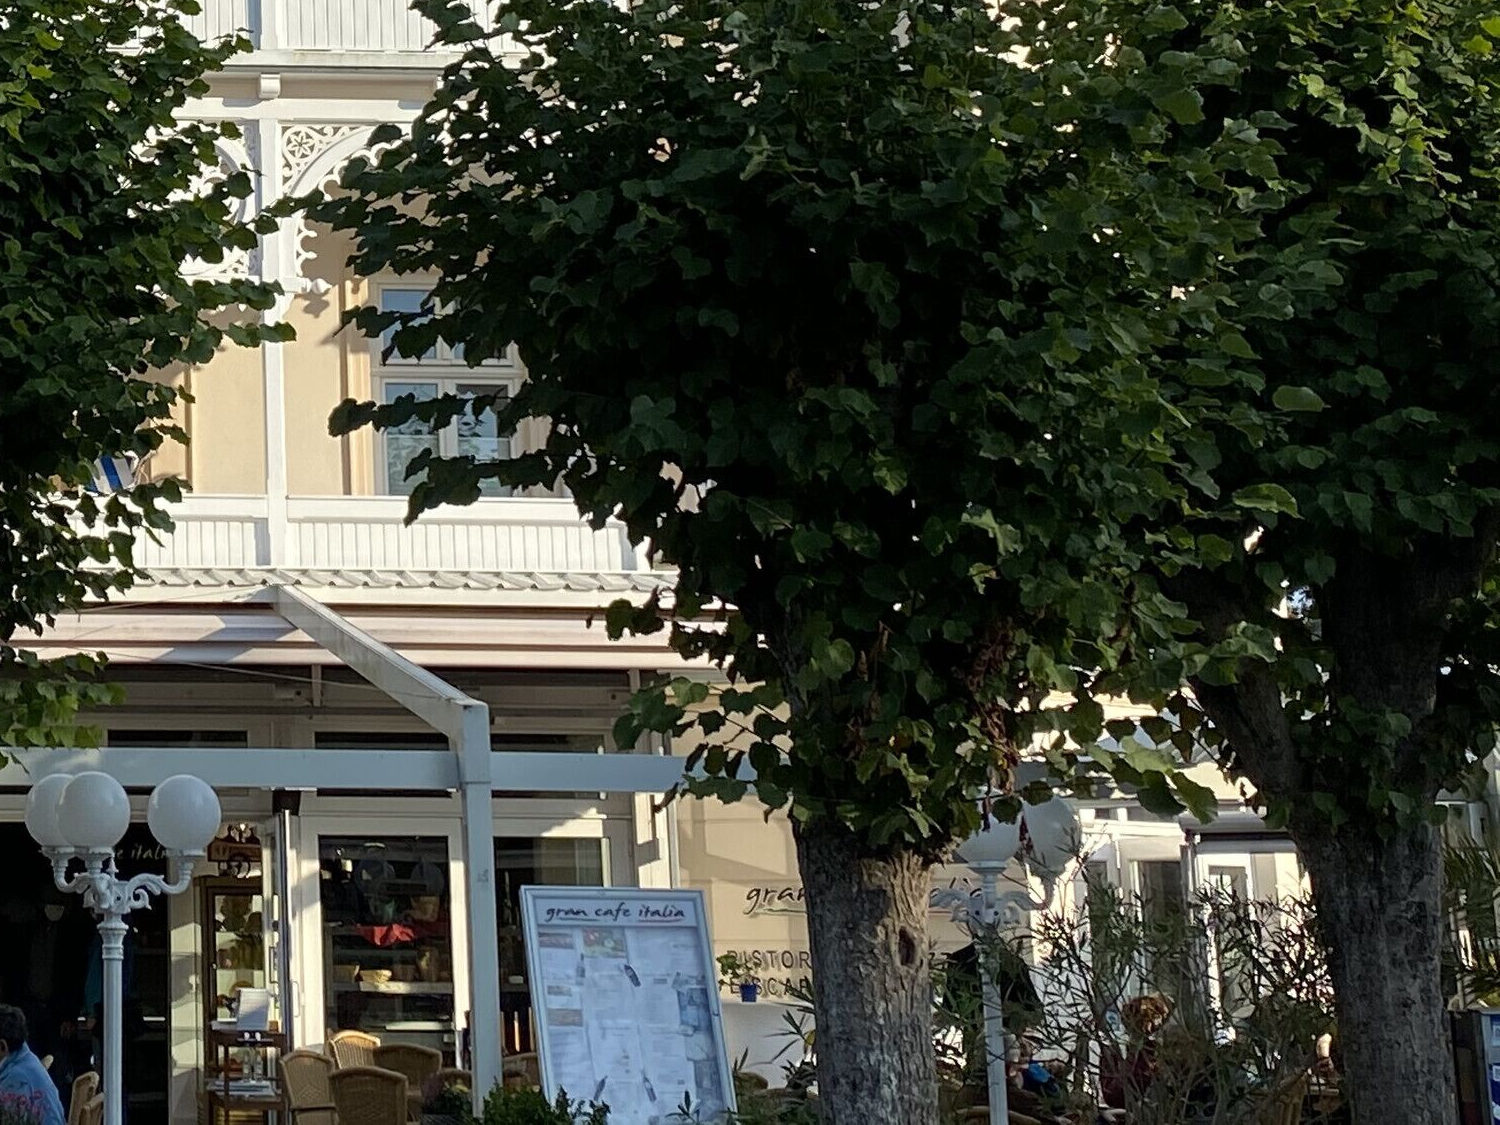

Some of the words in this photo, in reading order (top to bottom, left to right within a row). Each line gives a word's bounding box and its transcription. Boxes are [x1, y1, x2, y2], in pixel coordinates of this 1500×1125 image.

[544, 907, 588, 922] gran
[594, 901, 632, 921] cafe
[638, 903, 685, 919] italia
[726, 949, 812, 969] RISTOR
